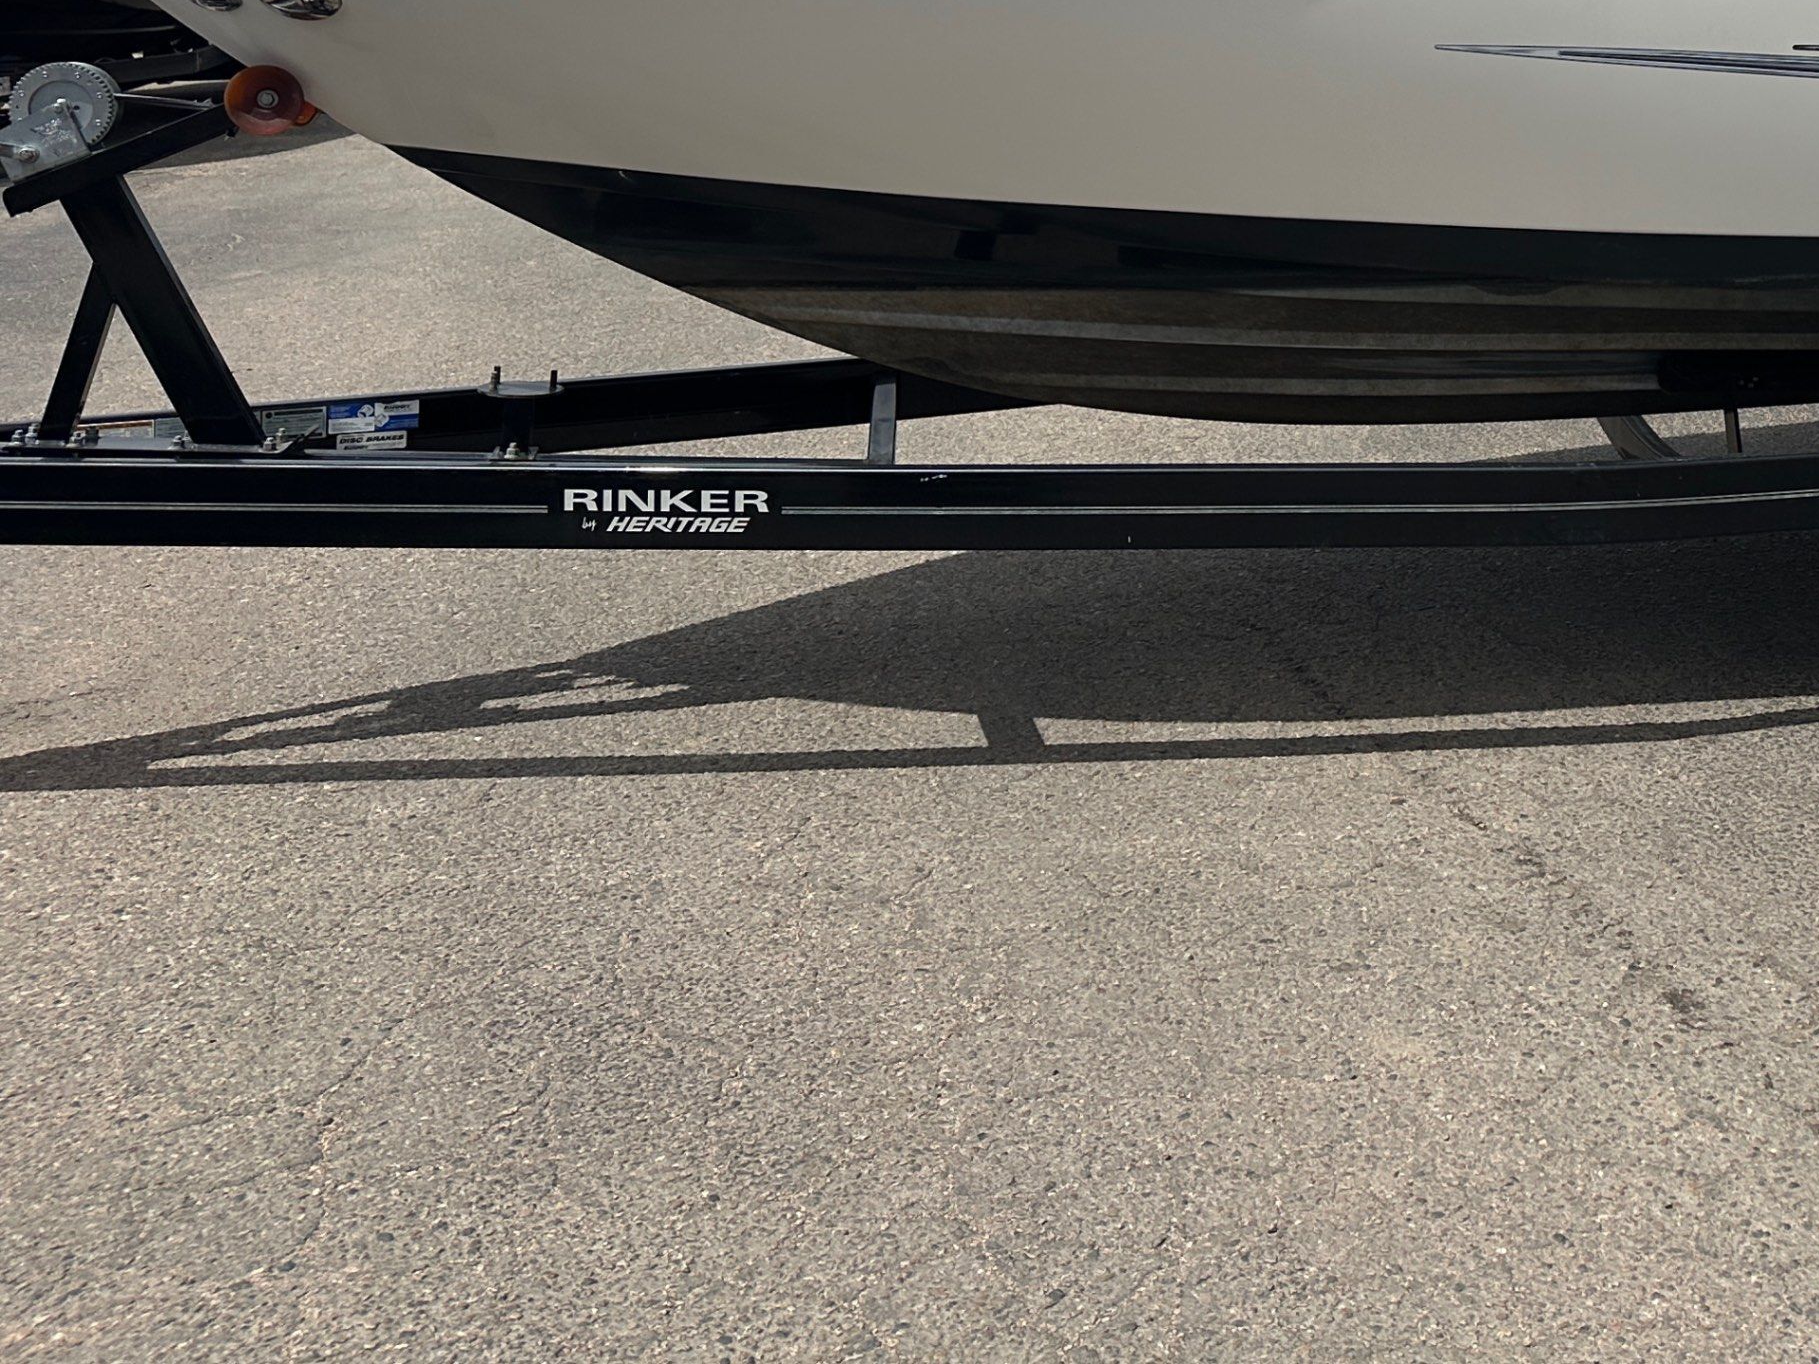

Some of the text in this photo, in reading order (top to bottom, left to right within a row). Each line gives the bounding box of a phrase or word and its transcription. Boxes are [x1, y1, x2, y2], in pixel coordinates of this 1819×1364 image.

[563, 489, 770, 513] RINKER
[581, 516, 751, 533] by HERITAGE
